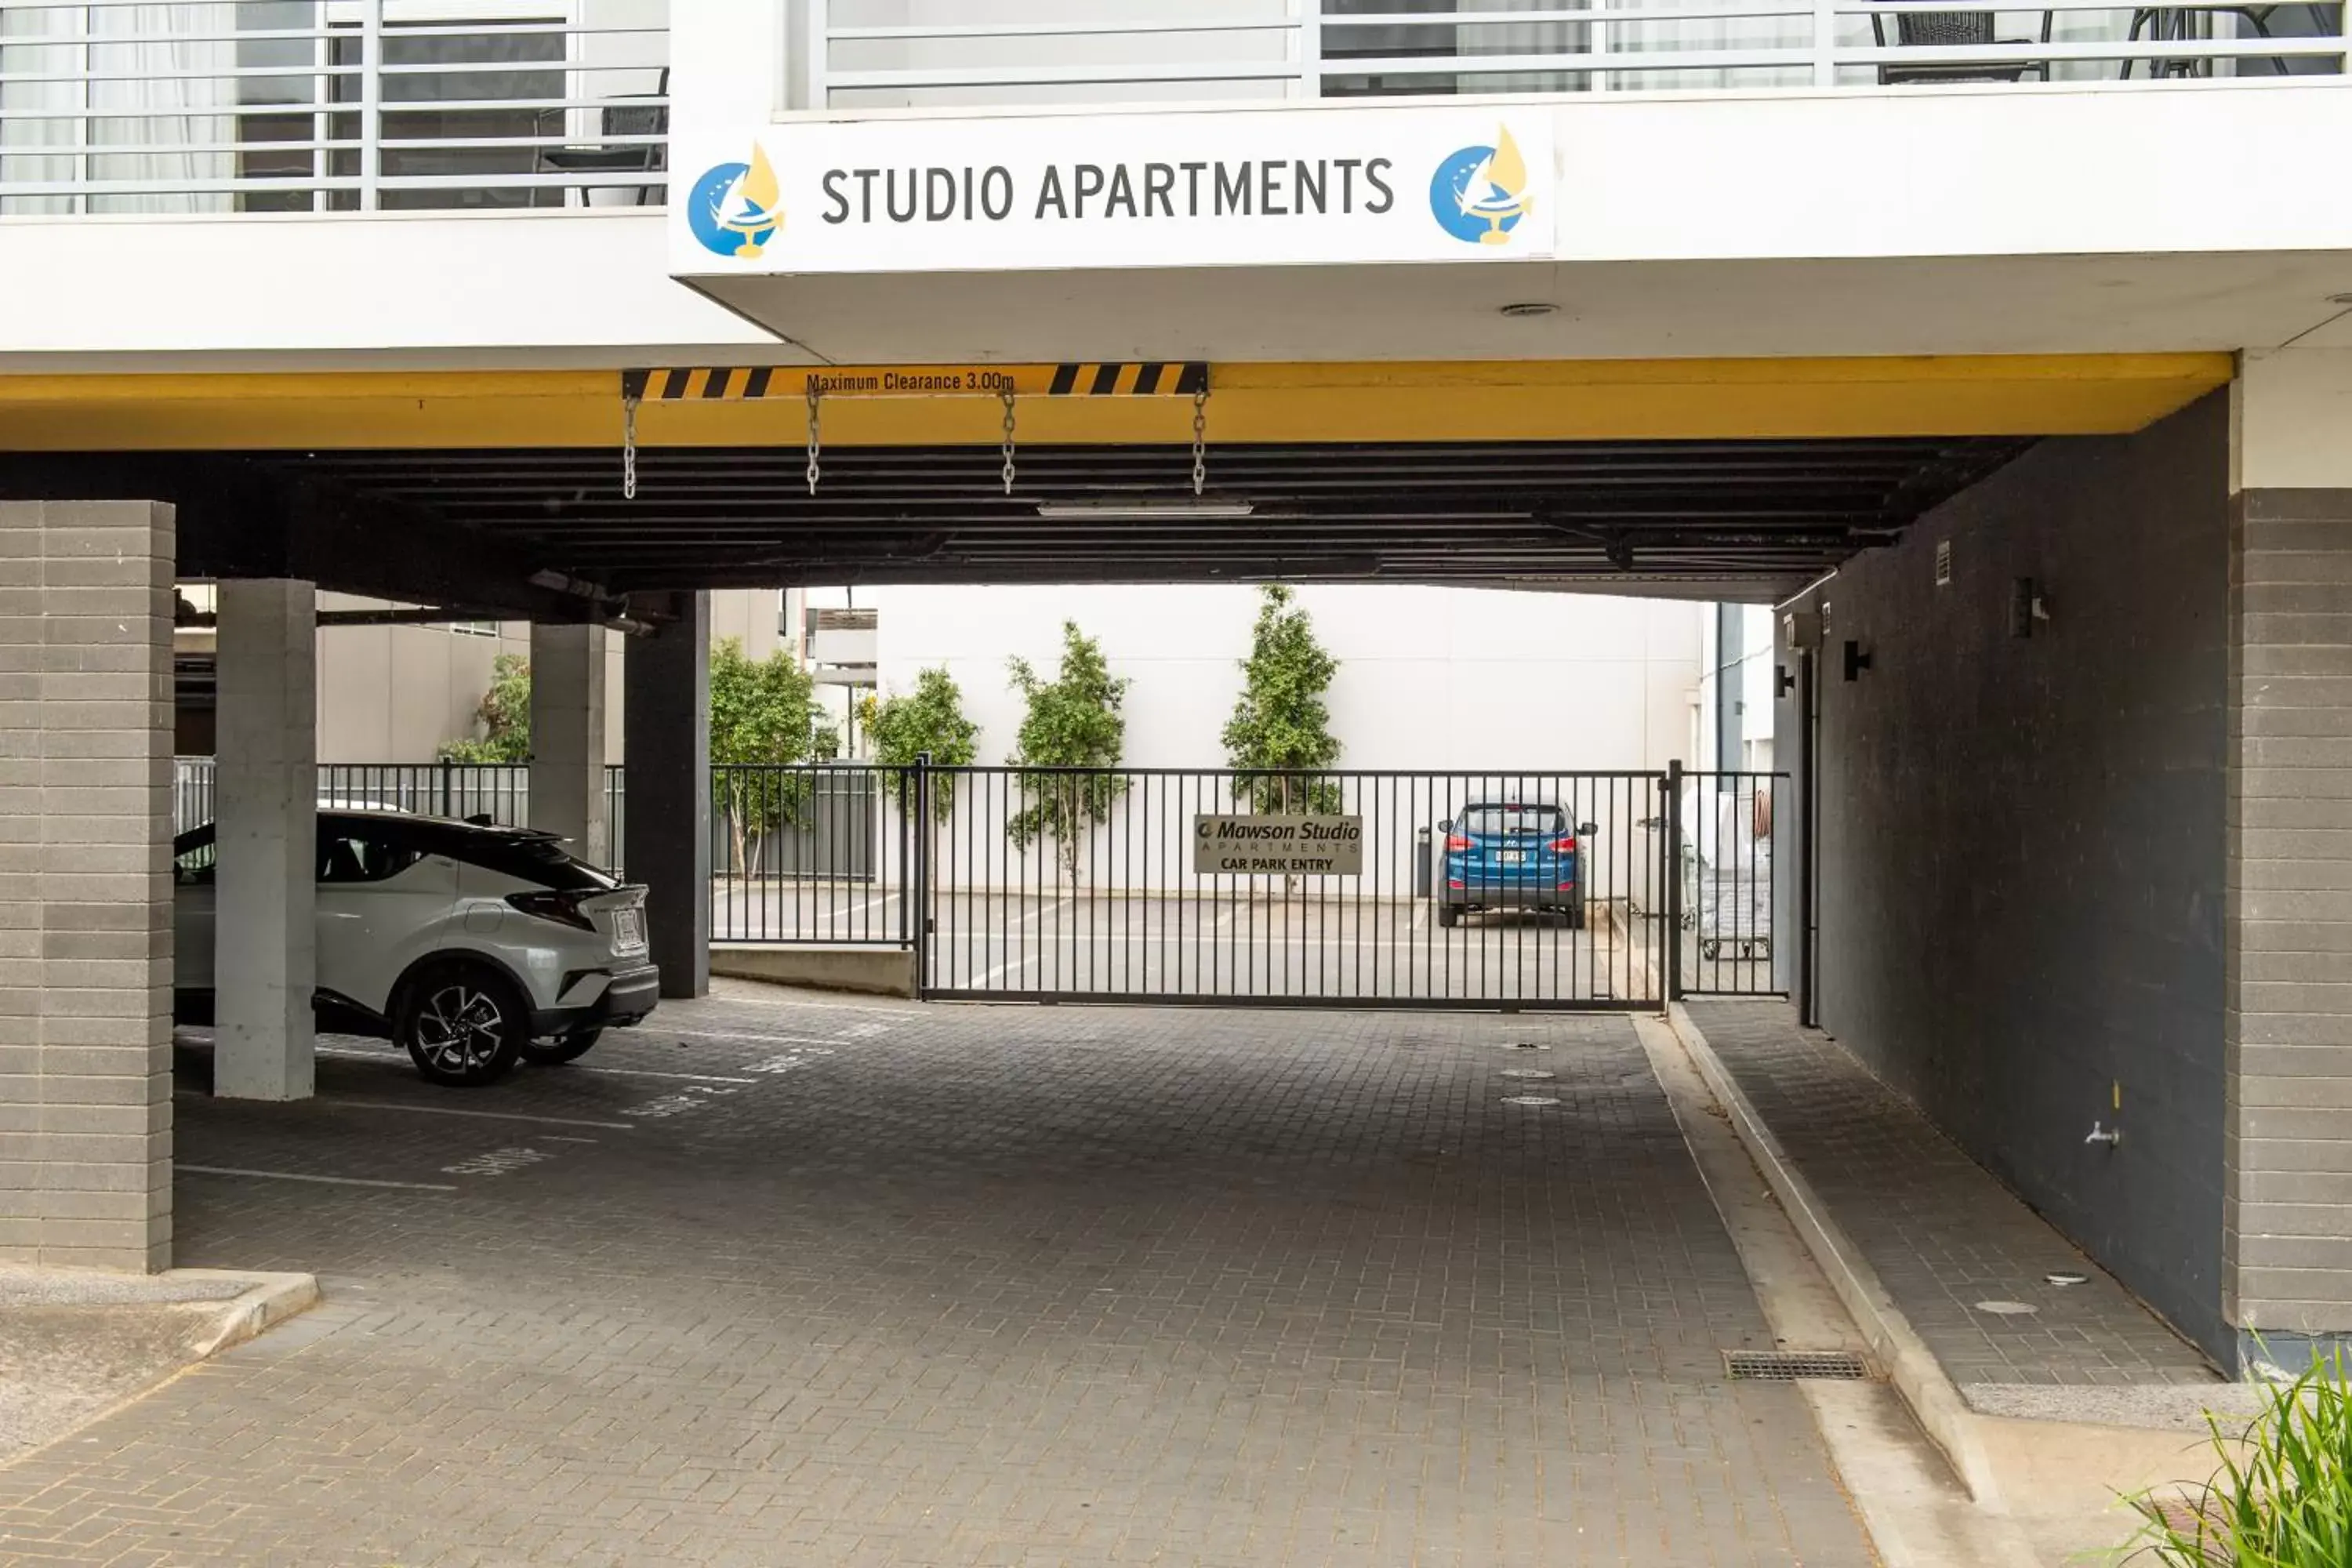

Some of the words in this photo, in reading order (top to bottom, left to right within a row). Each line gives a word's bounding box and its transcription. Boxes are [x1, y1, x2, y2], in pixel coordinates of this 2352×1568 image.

[821, 166, 1014, 224] STUDIO
[1034, 157, 1396, 220] APARTMENTS
[807, 374, 877, 390] Maximum
[884, 372, 960, 390] Clearance
[967, 372, 1014, 390] 3.00m
[1217, 822, 1295, 840] Mawson
[1299, 822, 1359, 840] Studio
[1202, 841, 1358, 853] APARTMENTS
[1221, 858, 1247, 869] CAR
[1252, 858, 1287, 870] PARK
[1291, 858, 1334, 871] ENTRY
